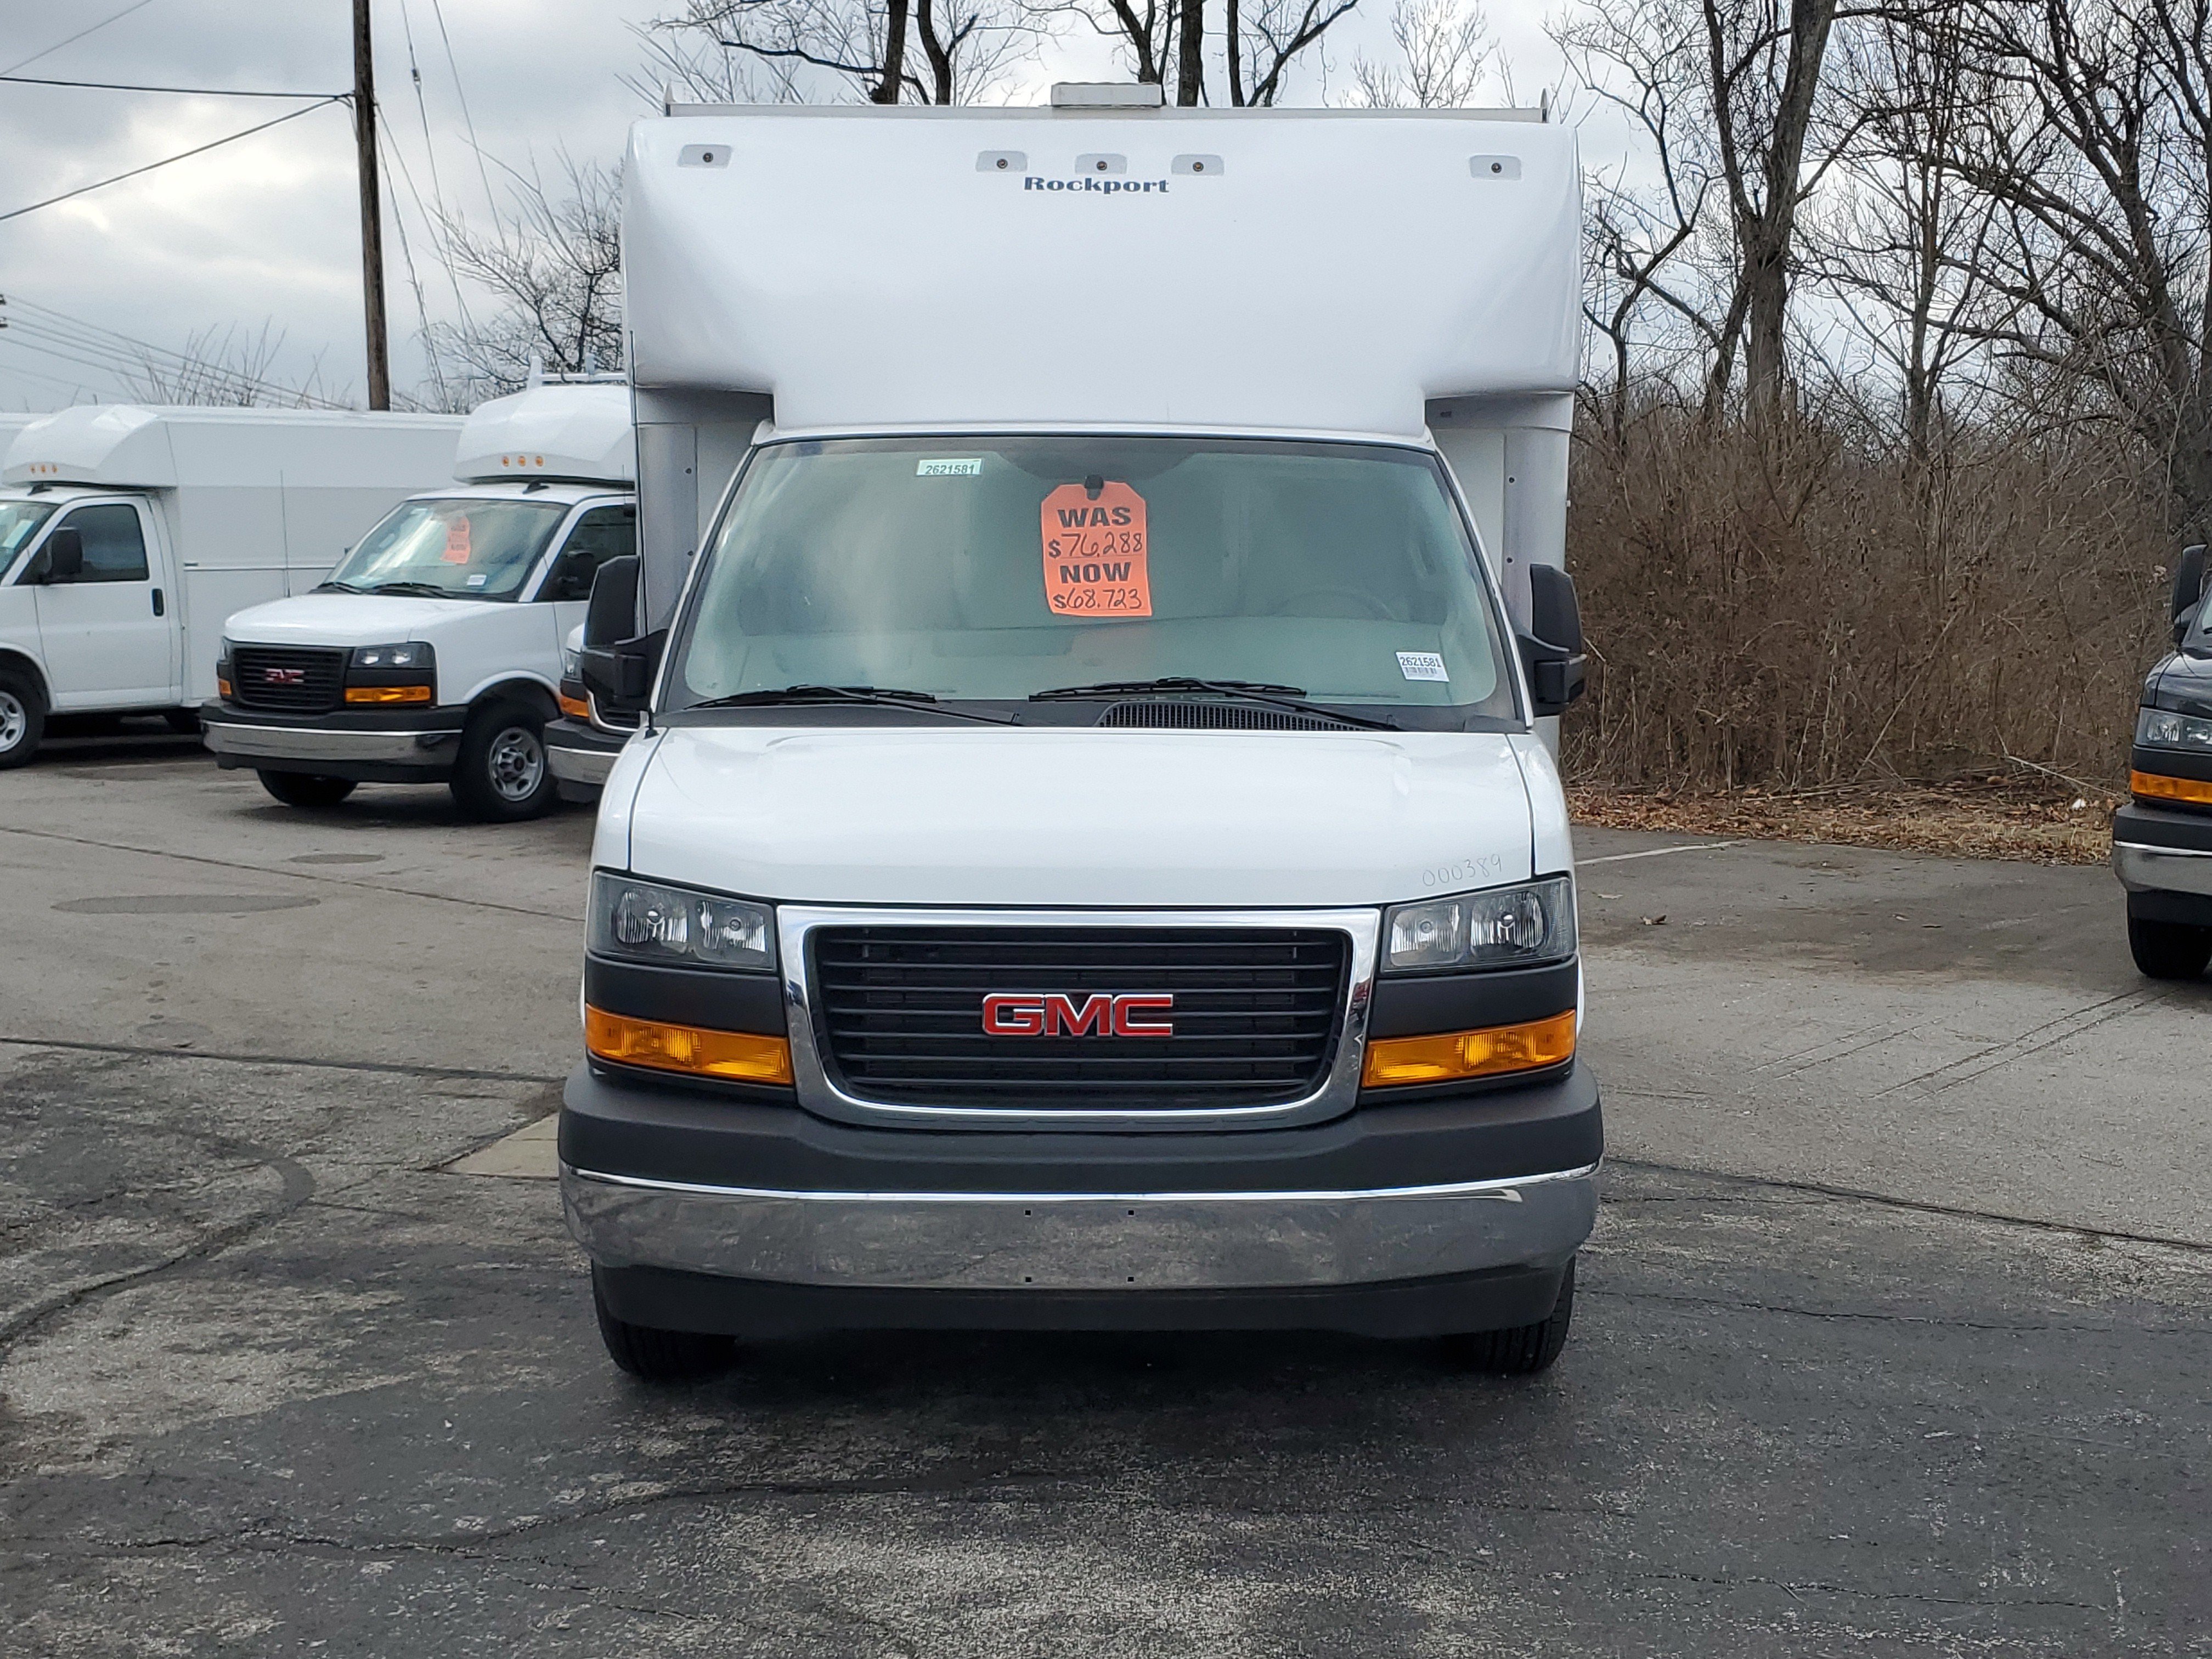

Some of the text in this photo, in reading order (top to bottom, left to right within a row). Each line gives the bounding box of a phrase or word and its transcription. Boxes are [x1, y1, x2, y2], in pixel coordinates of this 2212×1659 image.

[1024, 177, 1169, 194] Rockport
[925, 464, 975, 475] 2621581
[1058, 507, 1132, 528] WAS
[1060, 562, 1132, 584] NOW
[1399, 657, 1442, 668] 2621581
[1423, 854, 1502, 886] 000389
[983, 993, 1173, 1036] GMC
